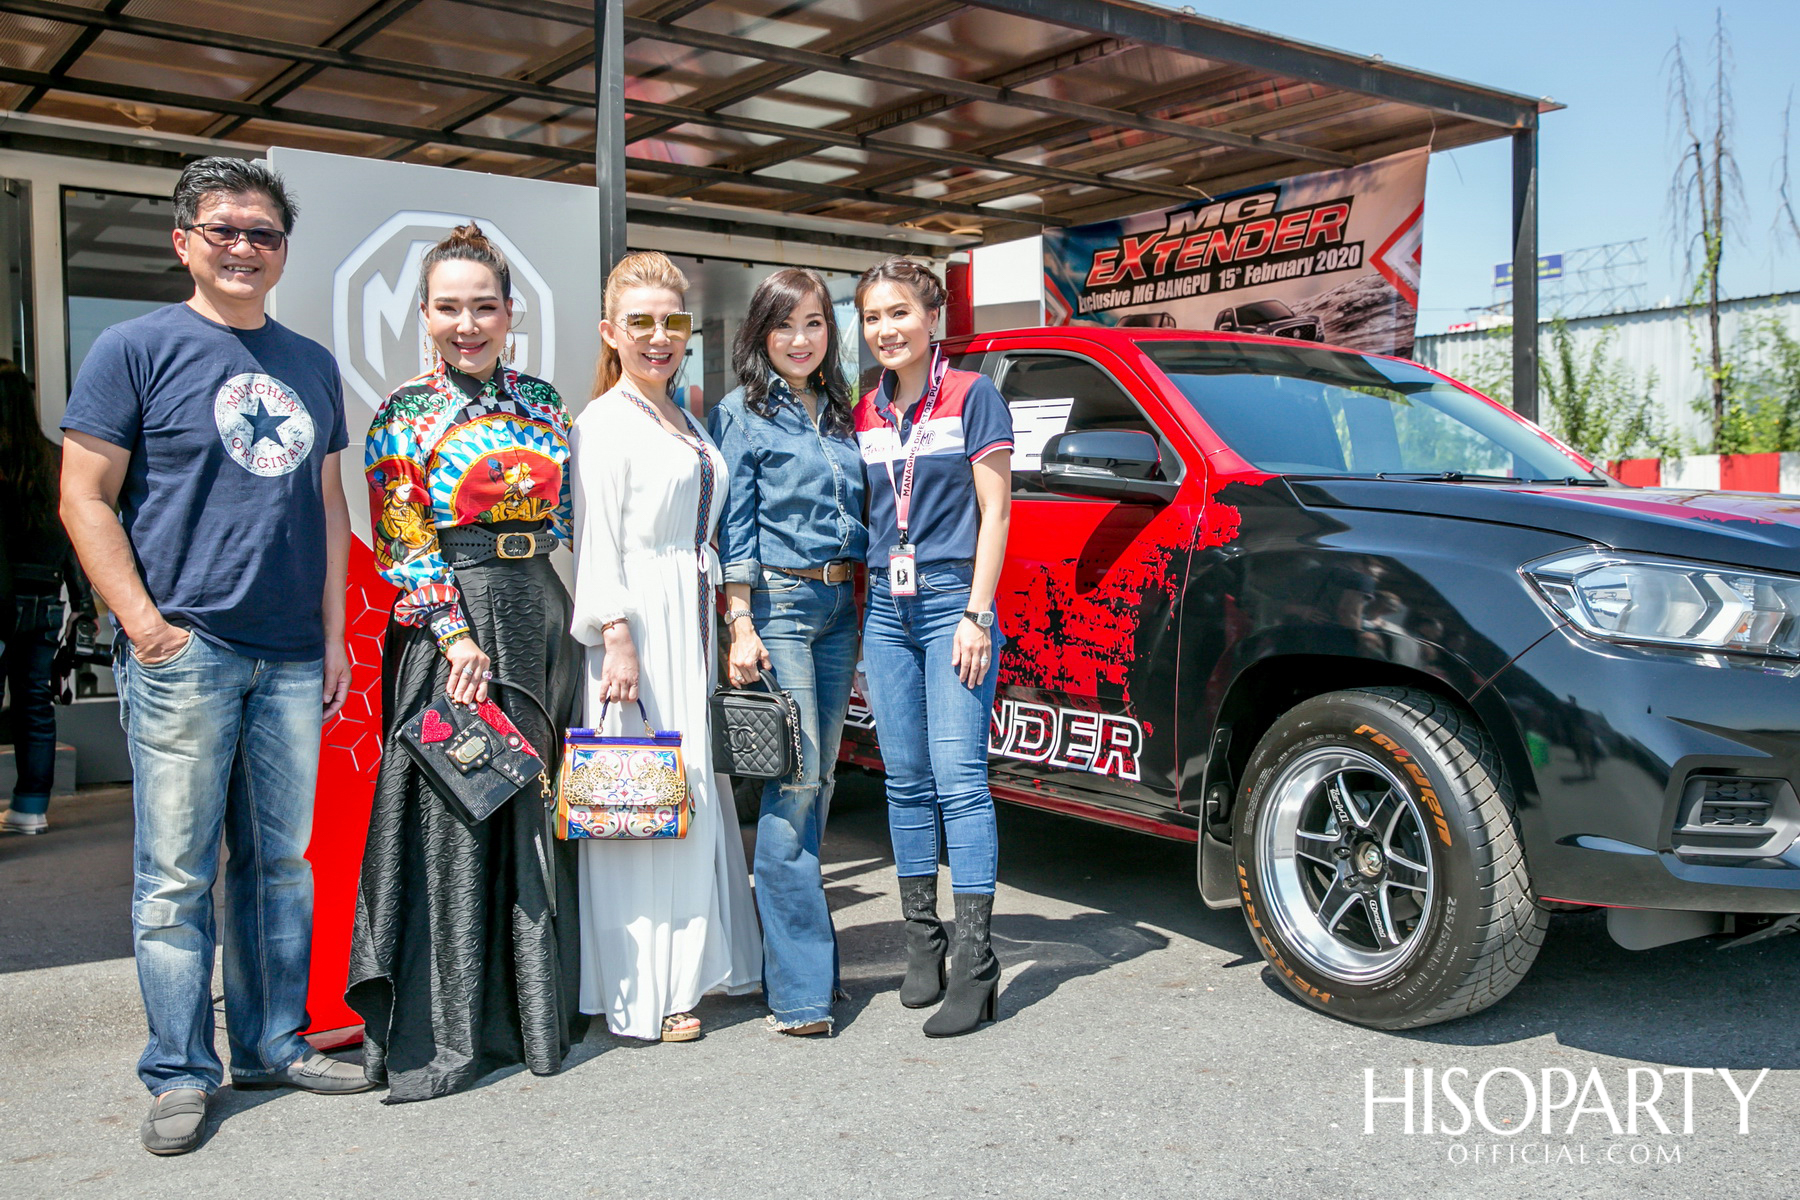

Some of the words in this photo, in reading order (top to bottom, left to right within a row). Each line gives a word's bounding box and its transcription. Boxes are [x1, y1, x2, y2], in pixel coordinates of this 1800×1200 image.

[1085, 202, 1350, 288] EXTENDER
[1165, 192, 1277, 238] MG
[1131, 283, 1155, 305] MG
[1155, 272, 1211, 301] BANGPU
[1243, 256, 1315, 286] February
[1315, 244, 1361, 272] 2020
[362, 239, 529, 384] M
[903, 447, 917, 496] MANAGING
[1261, 936, 1331, 1004] HERO
